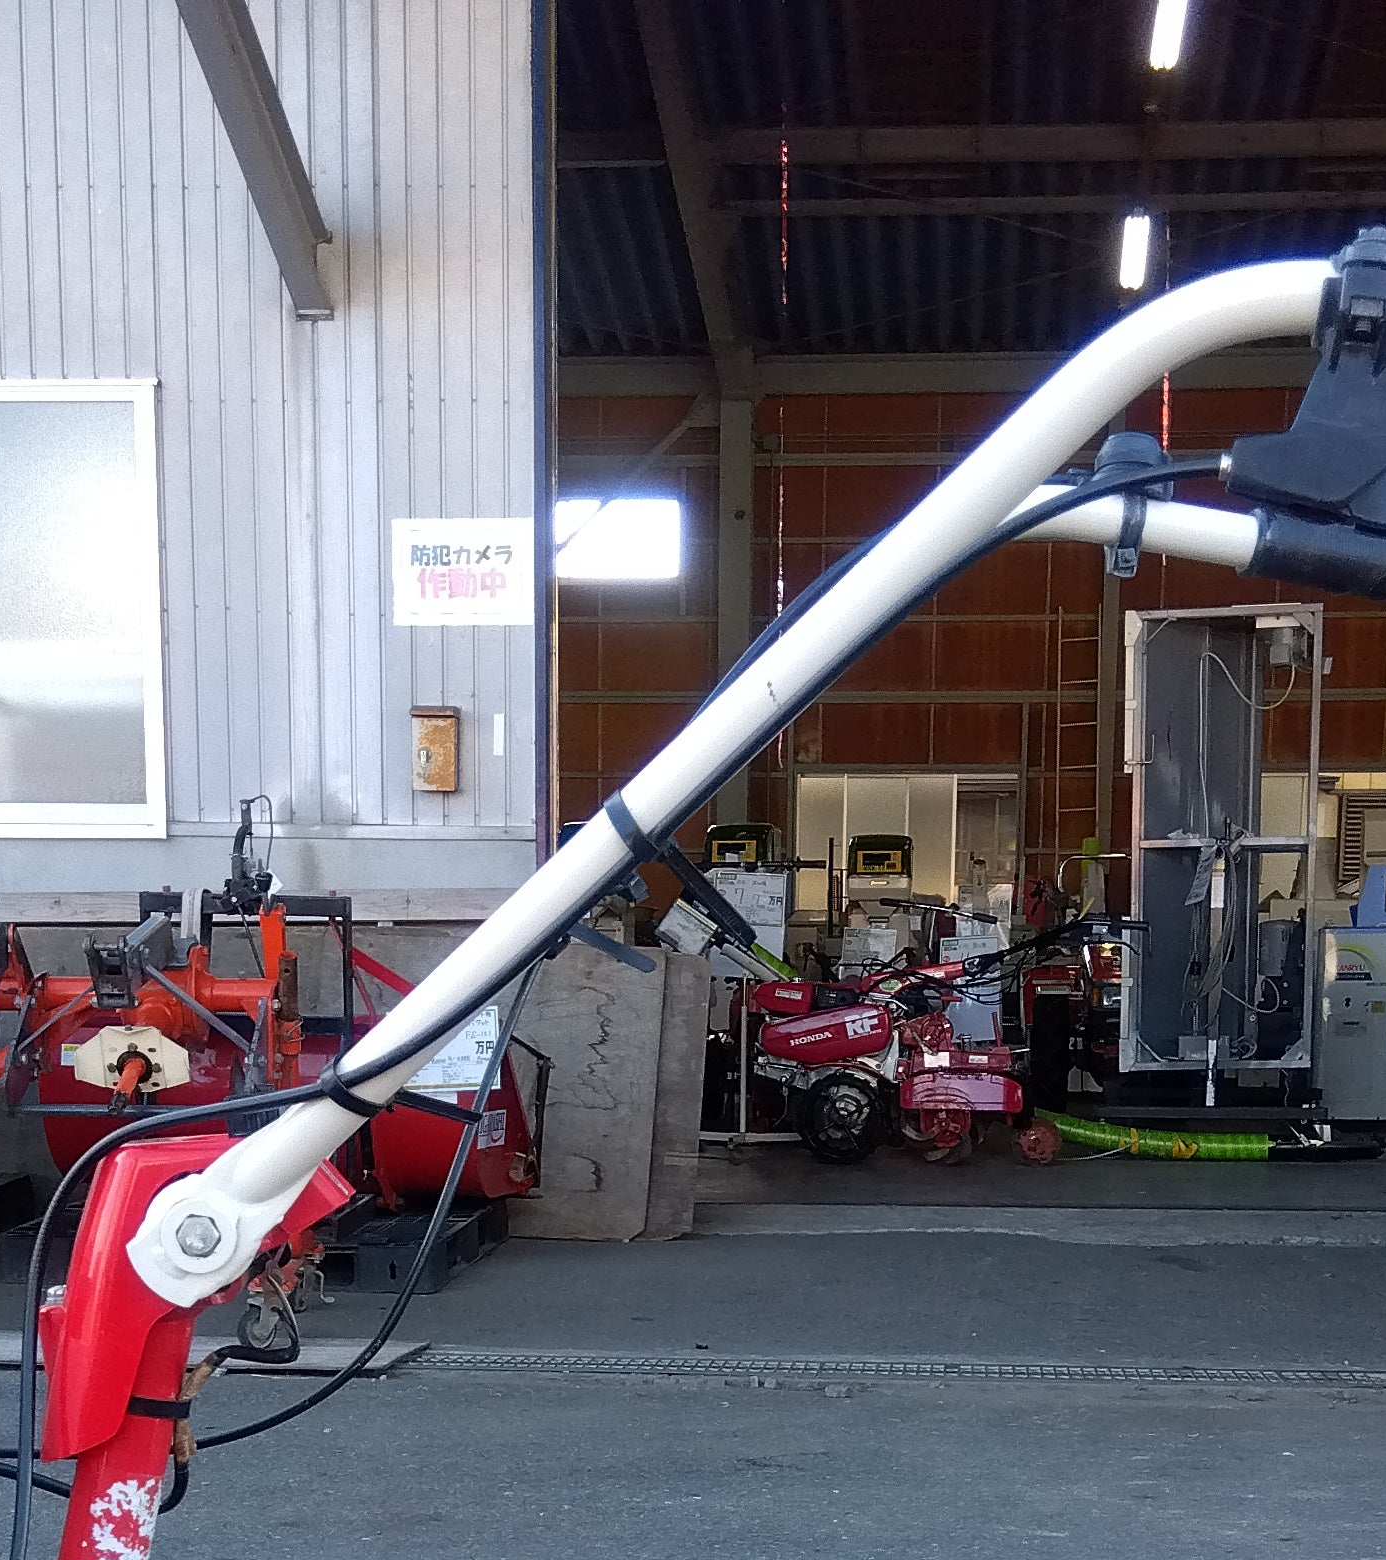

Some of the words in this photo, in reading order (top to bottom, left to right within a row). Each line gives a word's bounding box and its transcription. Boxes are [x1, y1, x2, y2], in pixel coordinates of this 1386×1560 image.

[411, 544, 513, 566] 防犯カメラ
[417, 567, 507, 599] 作動中
[844, 1009, 879, 1037] RF
[475, 1040, 494, 1055] 万円
[789, 1031, 834, 1046] HONDA
